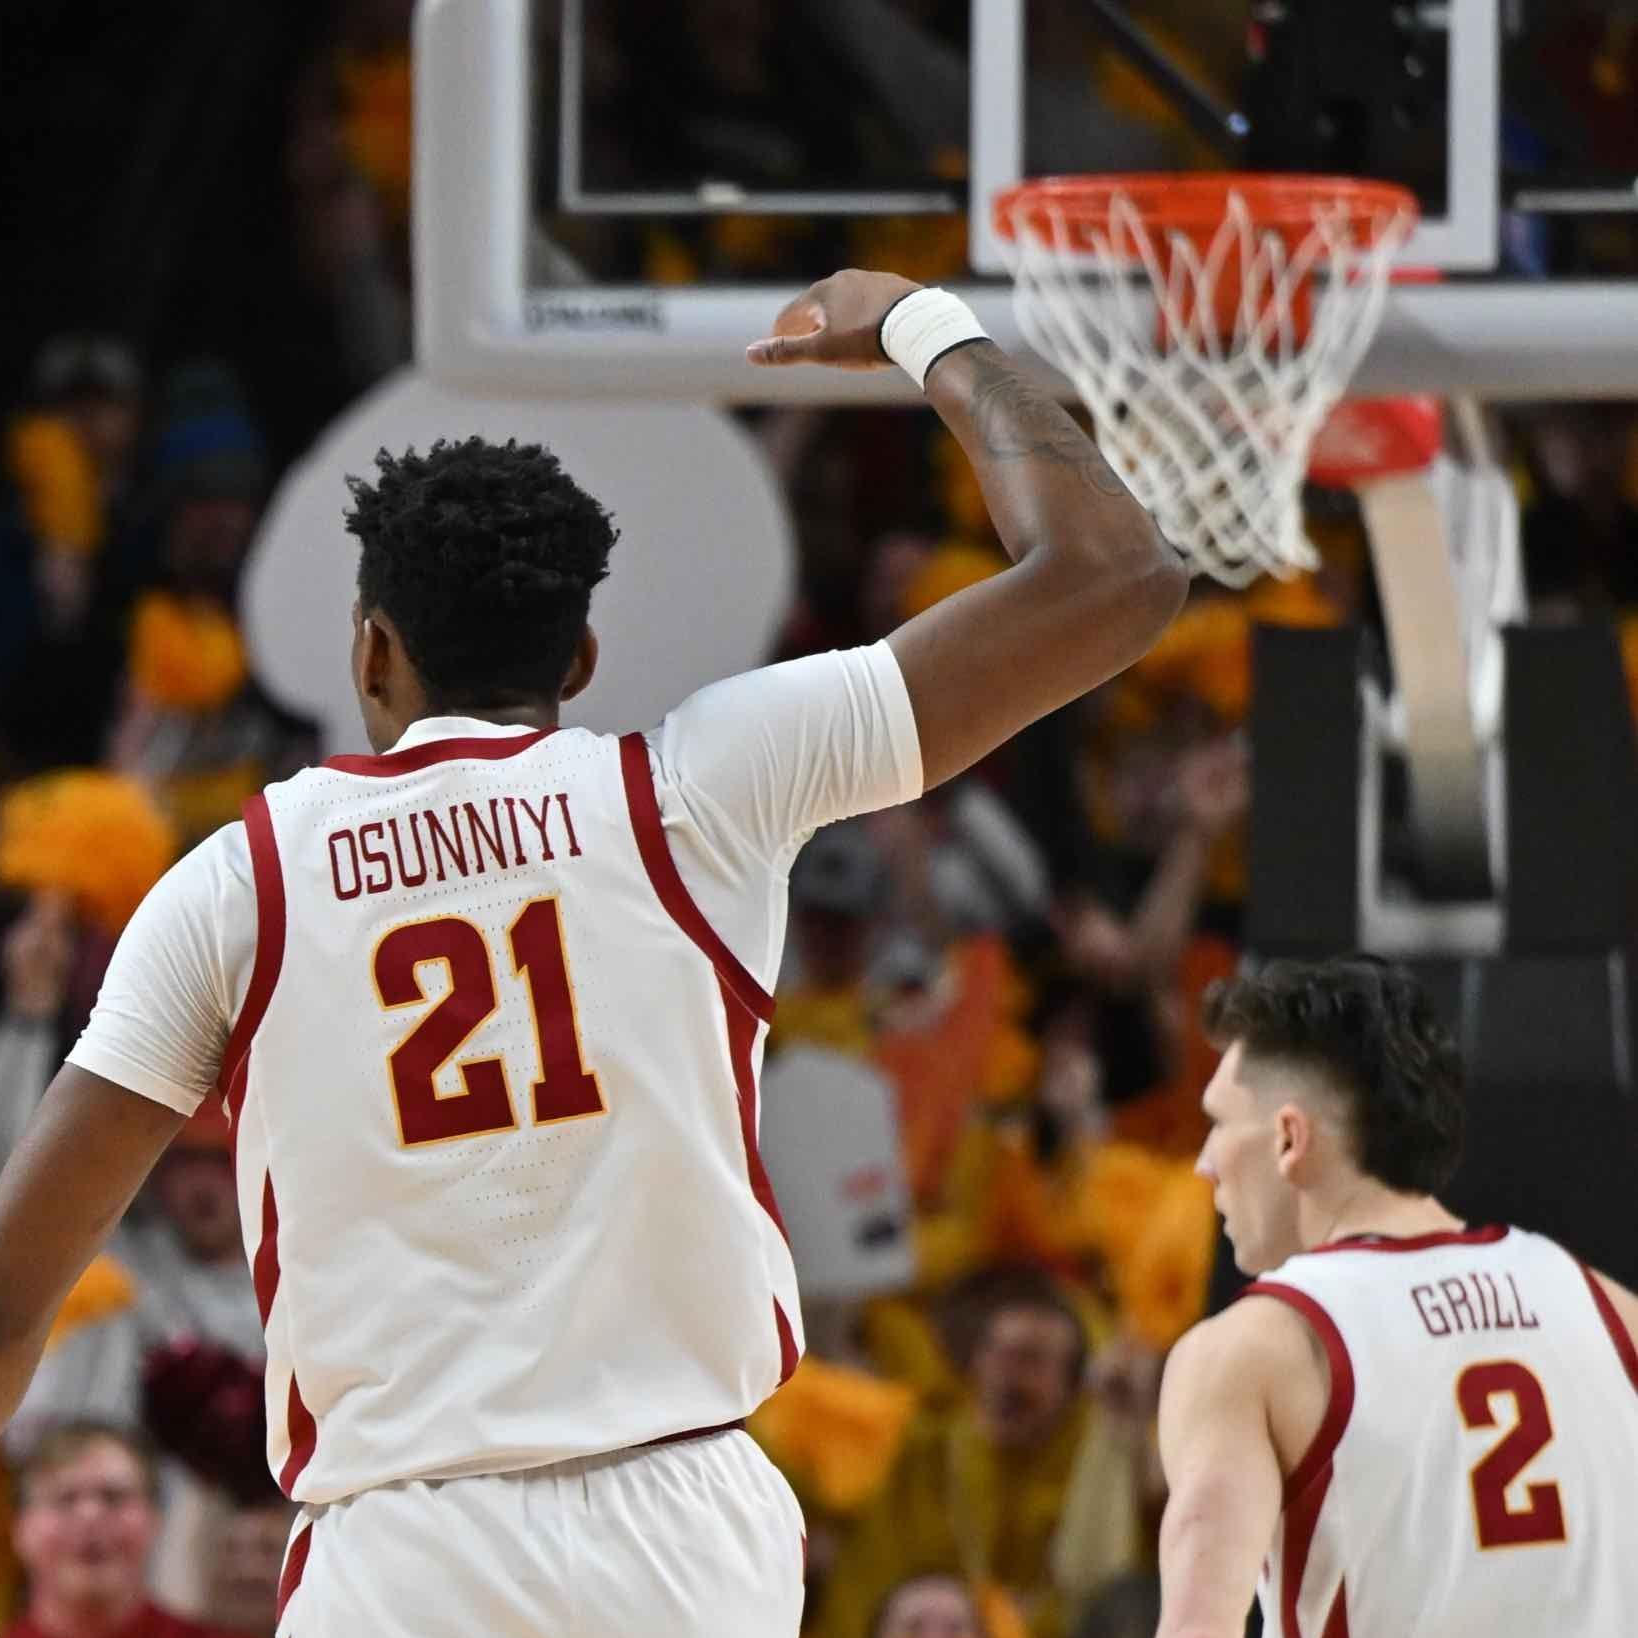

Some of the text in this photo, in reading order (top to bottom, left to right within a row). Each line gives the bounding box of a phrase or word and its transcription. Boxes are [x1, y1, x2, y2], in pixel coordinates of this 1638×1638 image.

[328, 793, 582, 900] OSUNNIYI
[371, 896, 607, 1148] 21
[1411, 1273, 1539, 1336] GRILL
[1455, 1359, 1567, 1552] 2
